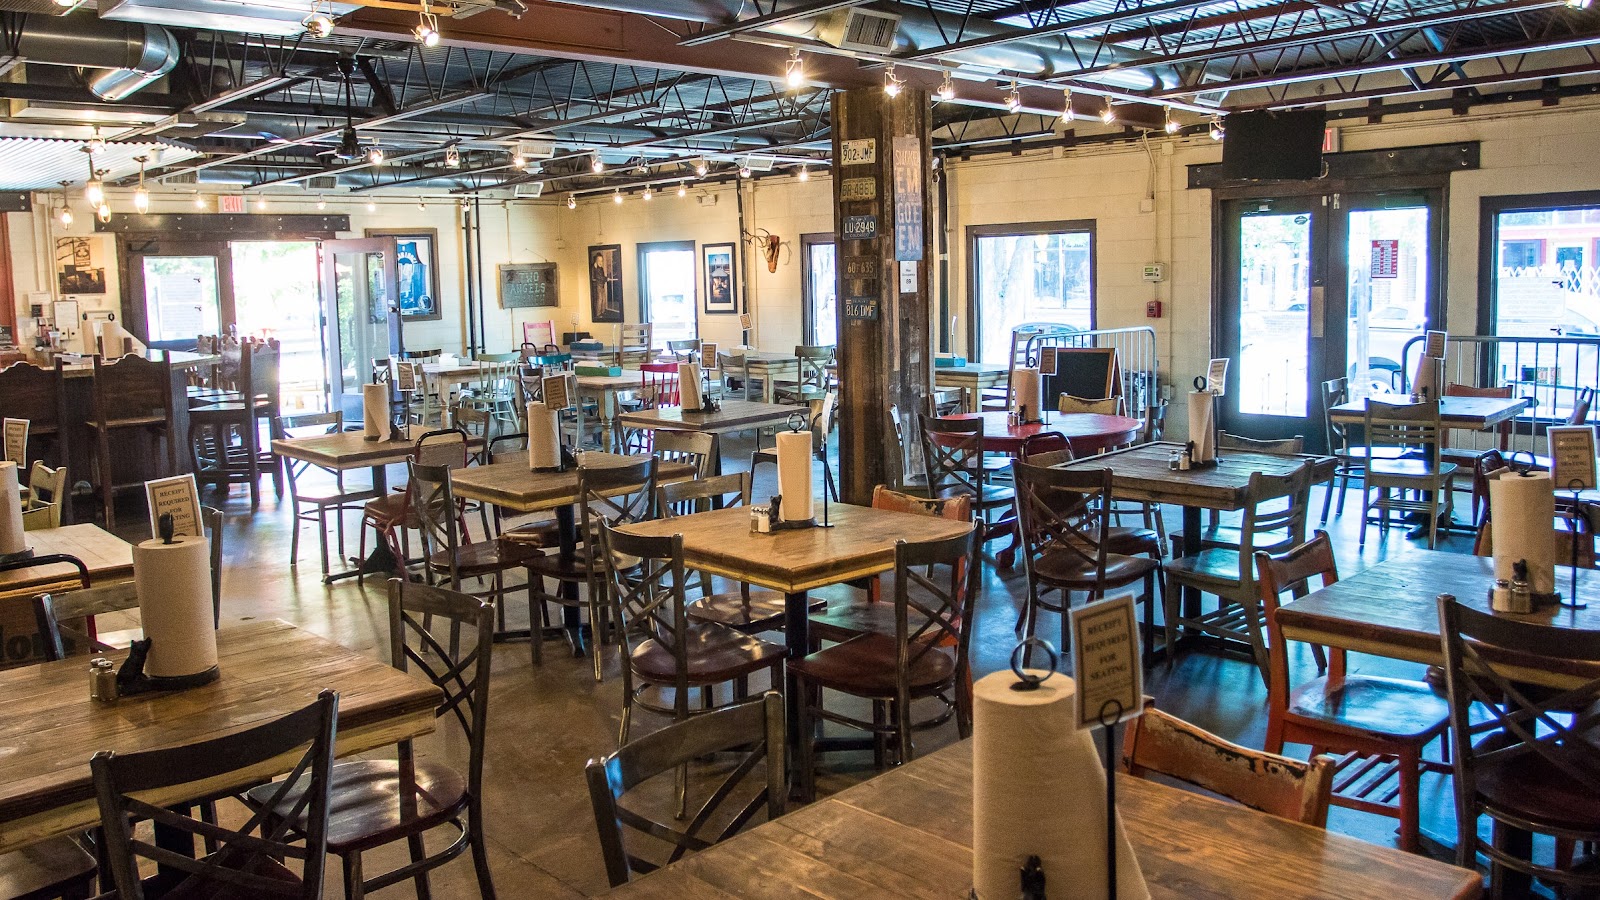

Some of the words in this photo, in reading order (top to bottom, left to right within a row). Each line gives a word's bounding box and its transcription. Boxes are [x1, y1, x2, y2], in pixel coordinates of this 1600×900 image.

[897, 202, 920, 224] GOT
[159, 489, 185, 497] RECEIPT
[158, 497, 190, 506] REQUIRED
[1088, 619, 1121, 635] RECEIPT
[1084, 633, 1128, 653] REQUIRED
[1099, 652, 1117, 664] FOR
[1091, 665, 1127, 680] SEATING
